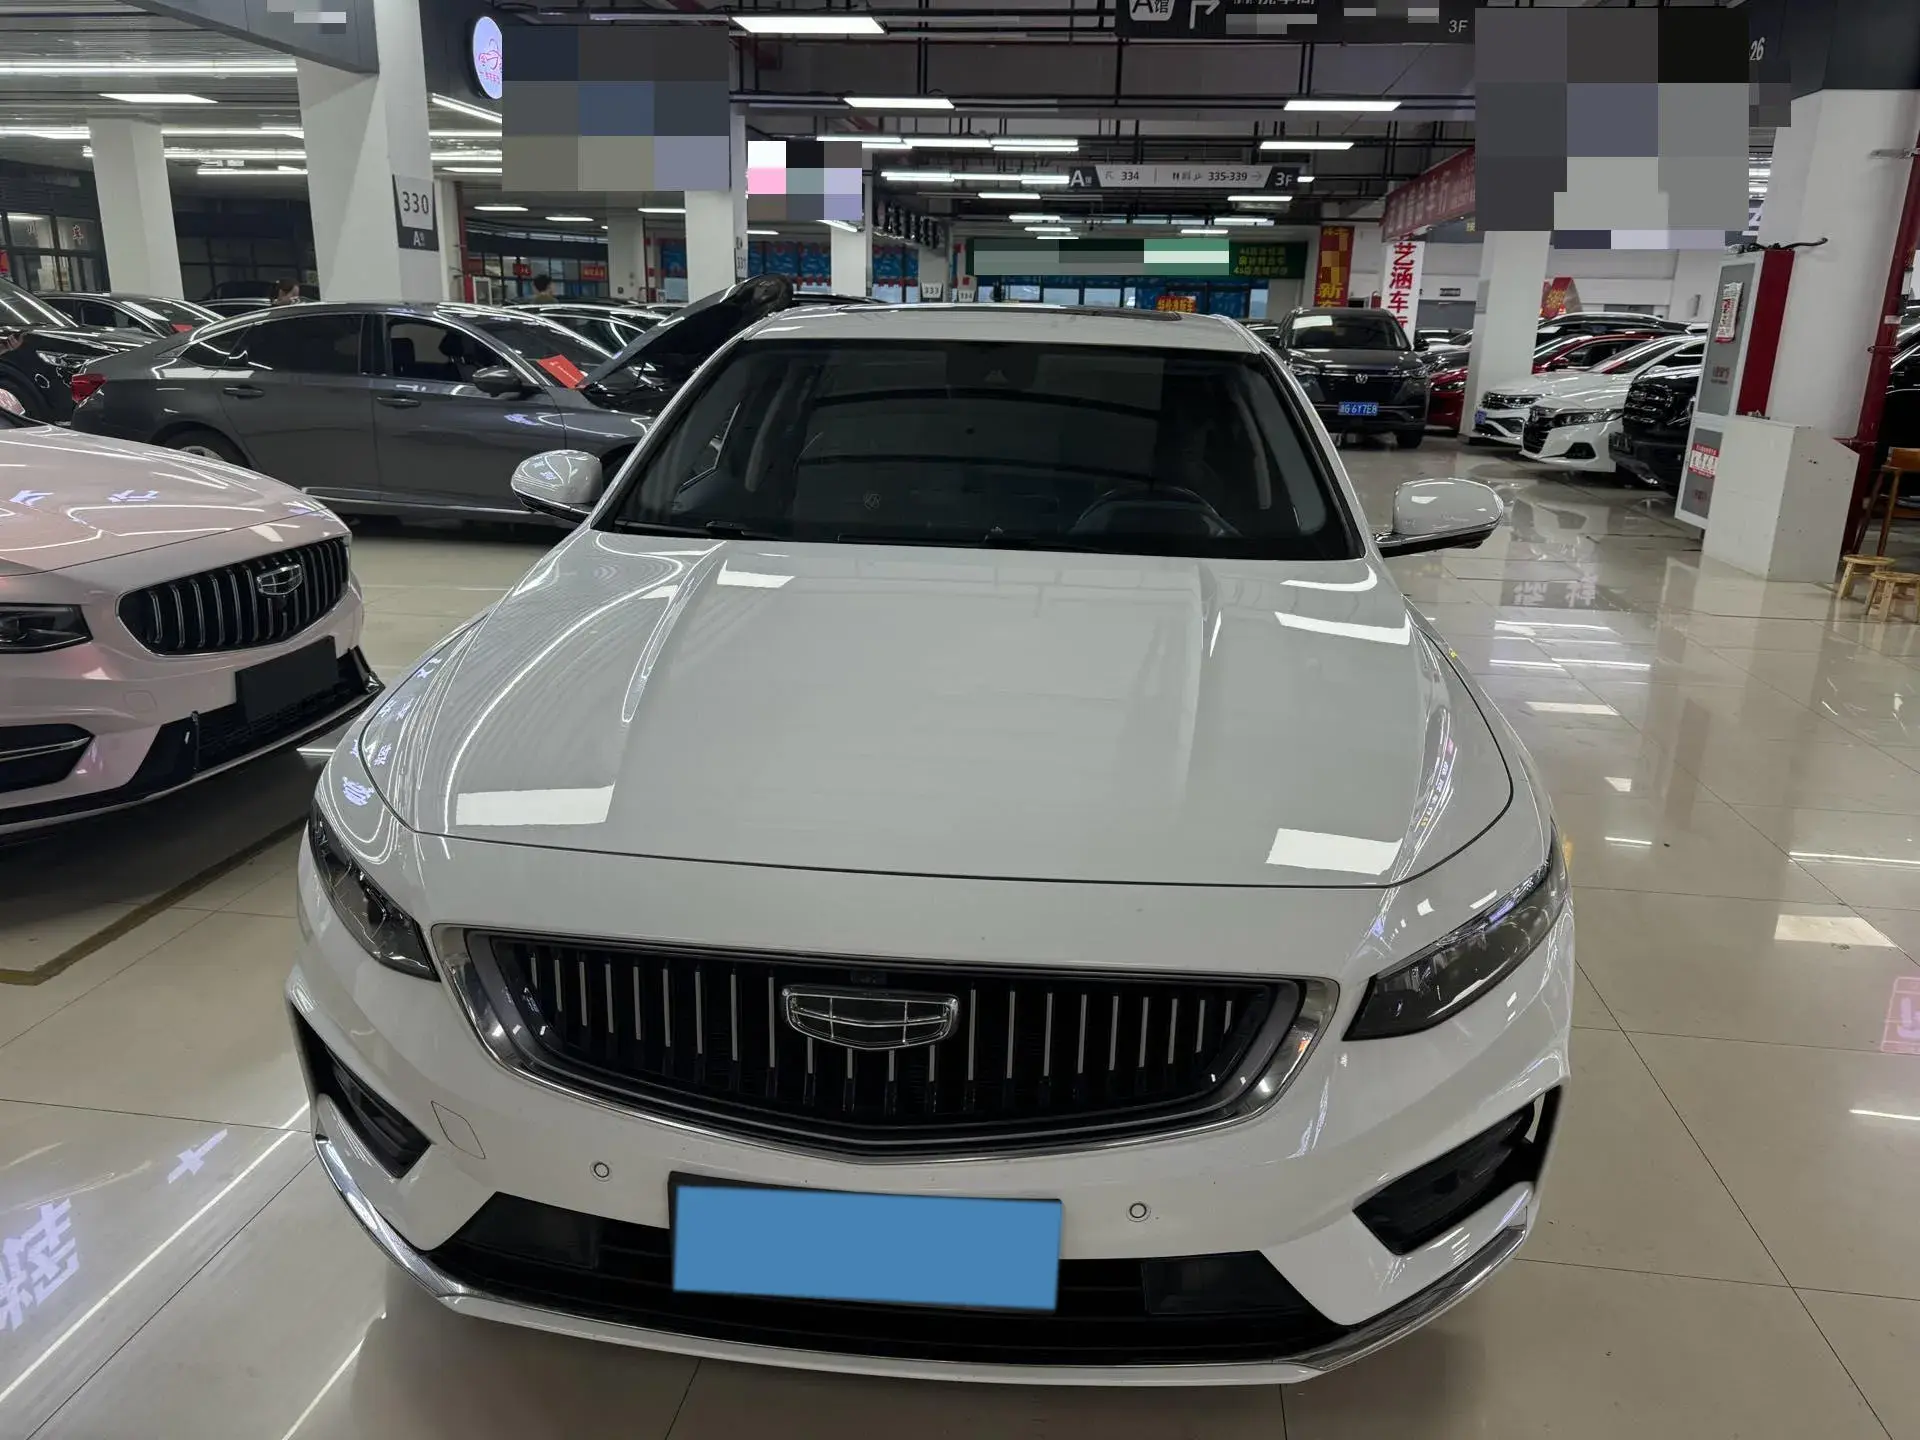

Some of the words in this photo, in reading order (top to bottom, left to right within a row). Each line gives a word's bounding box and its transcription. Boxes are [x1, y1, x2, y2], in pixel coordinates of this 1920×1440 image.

[1449, 20, 1469, 33] 3F
[1121, 171, 1139, 181] 334
[1208, 171, 1248, 181] 335-339
[1275, 172, 1293, 187] 3F
[402, 191, 429, 214] 330
